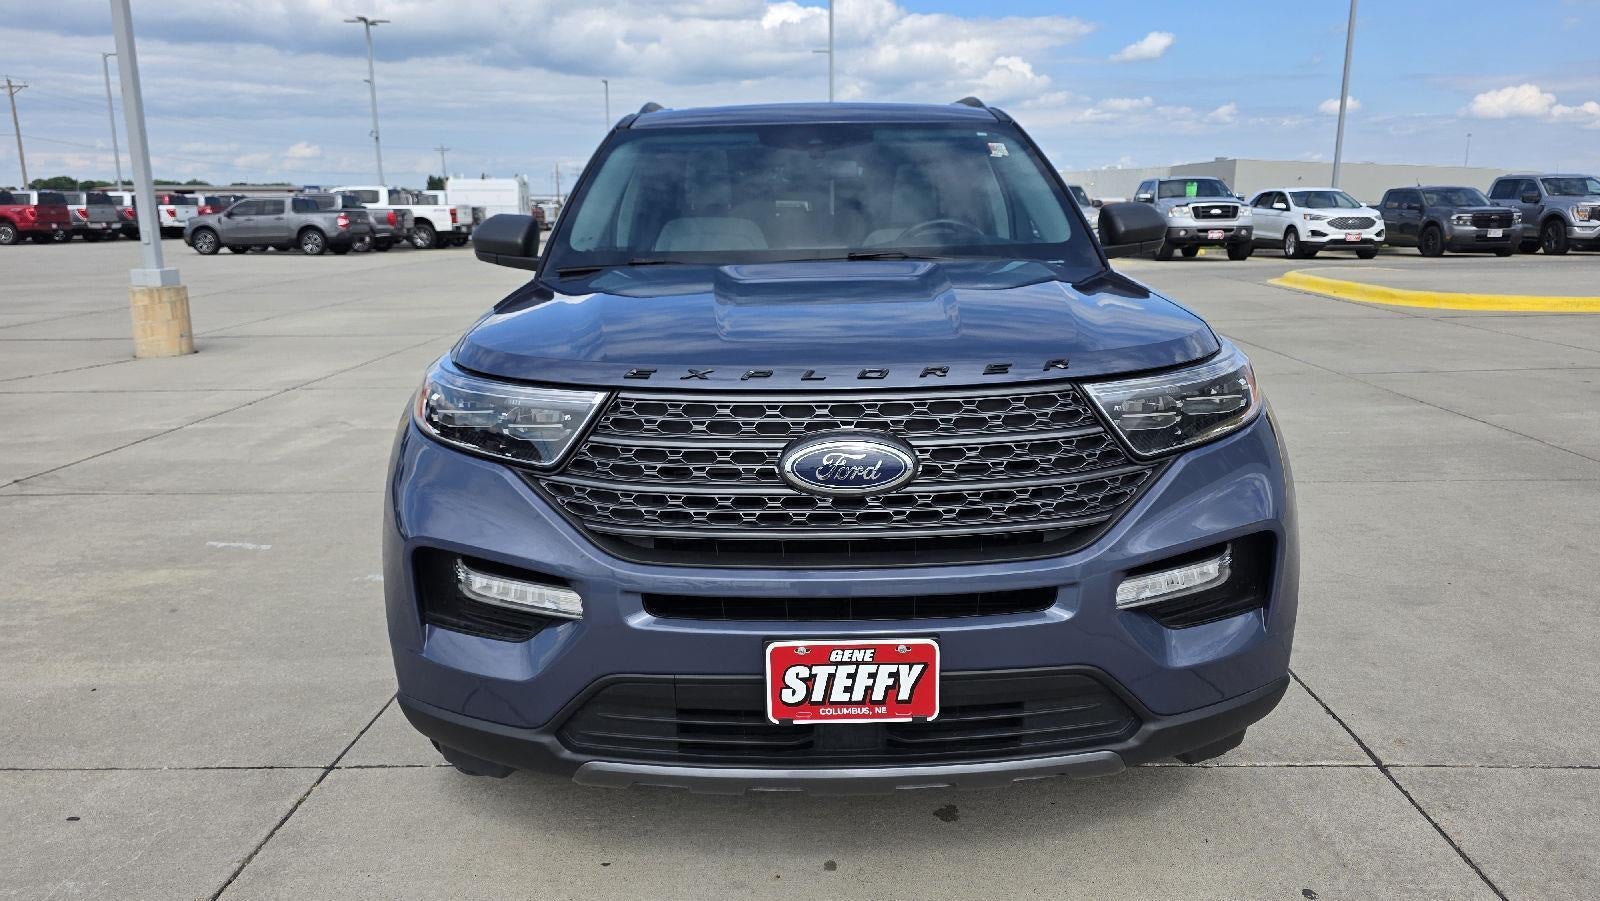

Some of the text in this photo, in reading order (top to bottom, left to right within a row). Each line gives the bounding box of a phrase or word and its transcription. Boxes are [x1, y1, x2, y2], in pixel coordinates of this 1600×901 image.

[623, 358, 1070, 381] EXPLORER
[815, 452, 883, 480] Ford
[829, 649, 875, 662] GENE
[780, 662, 929, 706] STEFFY
[819, 706, 888, 716] COLUMBUS, NE
